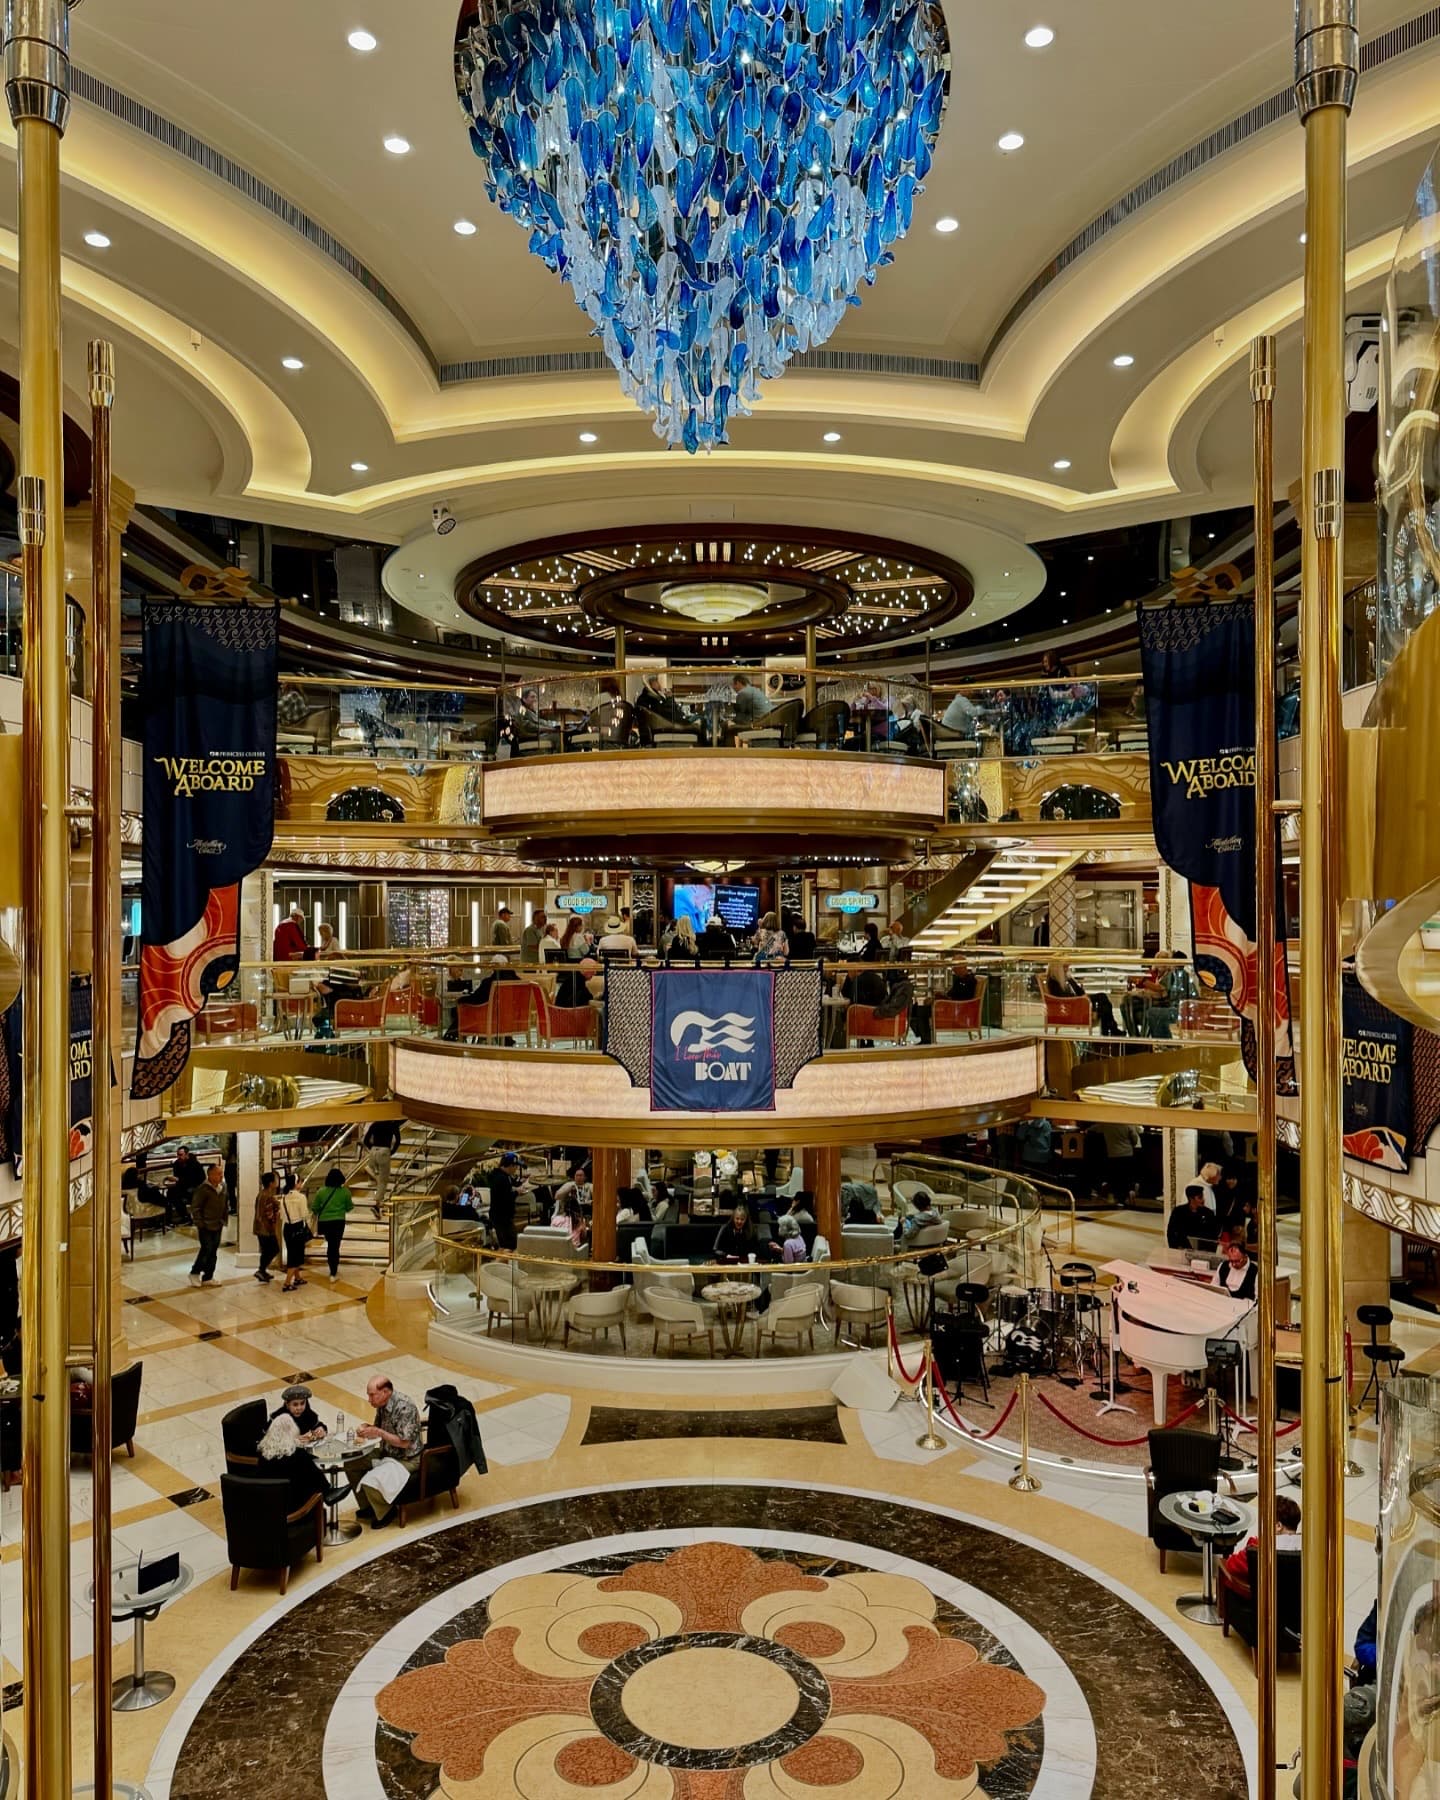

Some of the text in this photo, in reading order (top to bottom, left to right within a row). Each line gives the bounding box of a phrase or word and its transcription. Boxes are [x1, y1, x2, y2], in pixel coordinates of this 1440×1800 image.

[154, 757, 266, 780] WELCOME
[1160, 755, 1256, 784] WELCOM
[174, 774, 254, 797] ABOARD
[564, 897, 602, 906] GOOD SPIRITS
[831, 897, 872, 906] GOOD SPIRITS
[695, 1062, 752, 1081] BOAT
[1343, 1057, 1392, 1086] ABOARD
